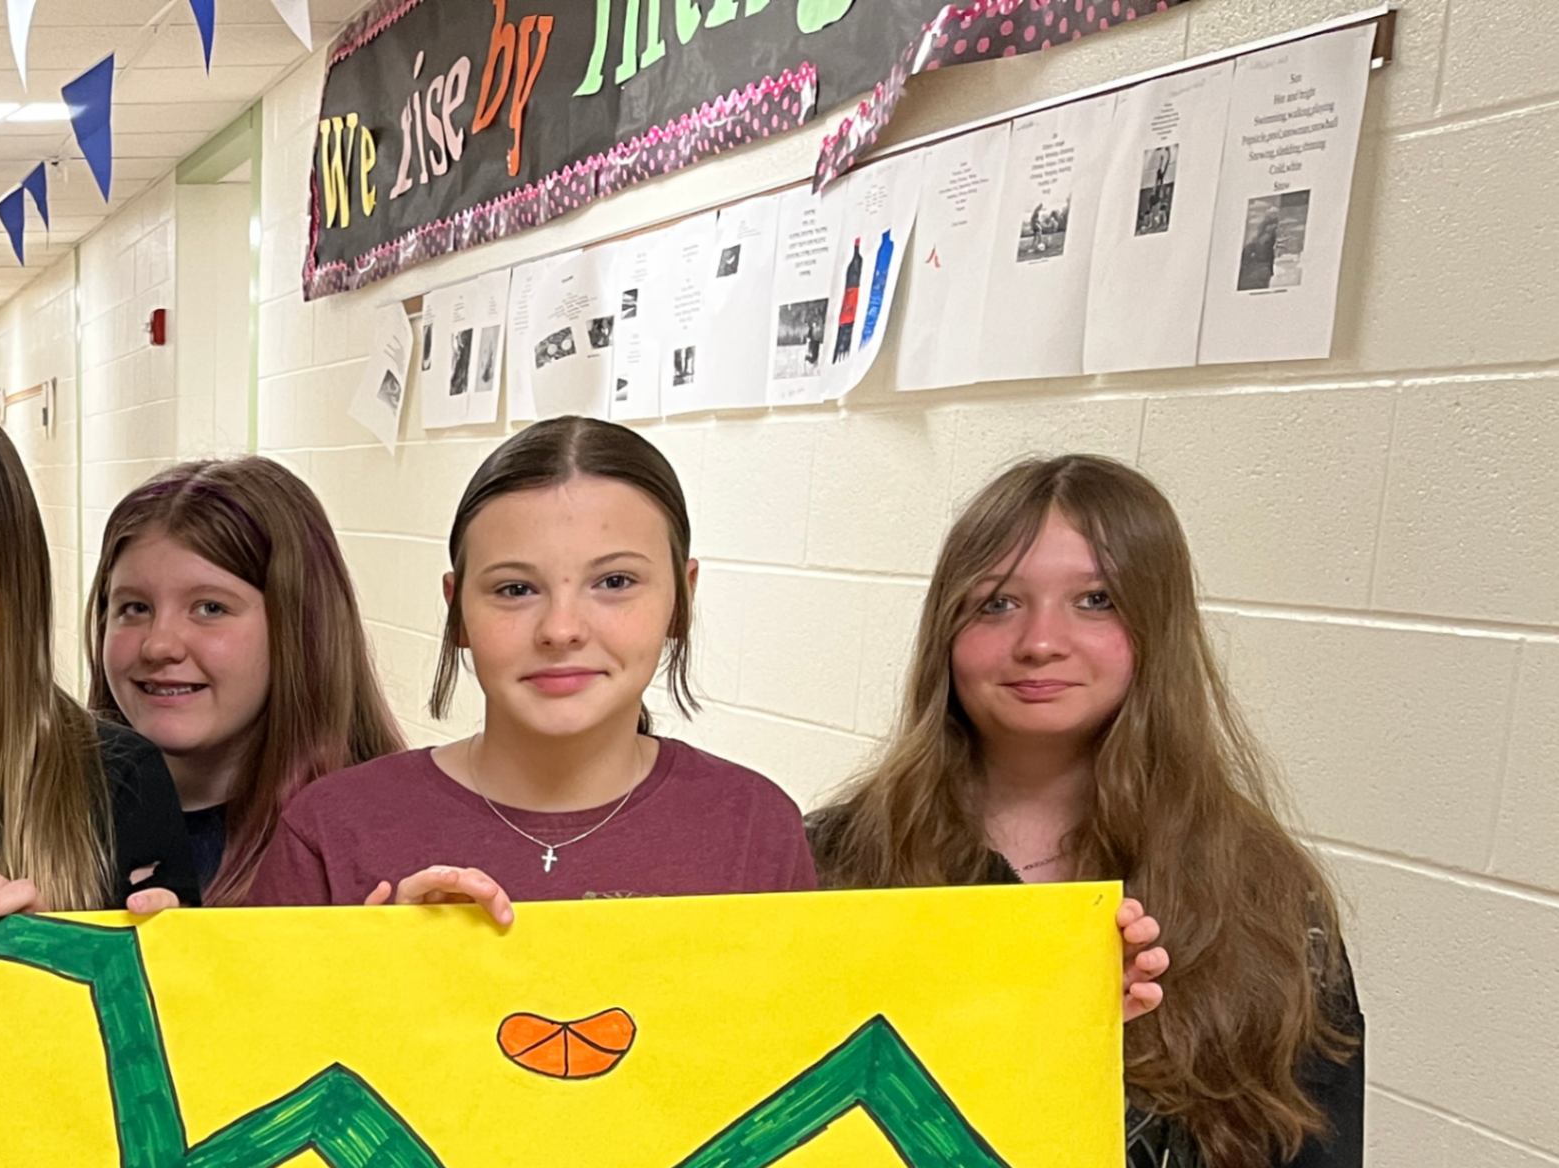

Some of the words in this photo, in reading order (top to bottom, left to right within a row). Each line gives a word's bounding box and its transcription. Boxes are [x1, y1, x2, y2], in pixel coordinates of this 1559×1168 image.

[320, 113, 377, 228] We
[389, 50, 472, 200] rise
[471, 0, 555, 177] by
